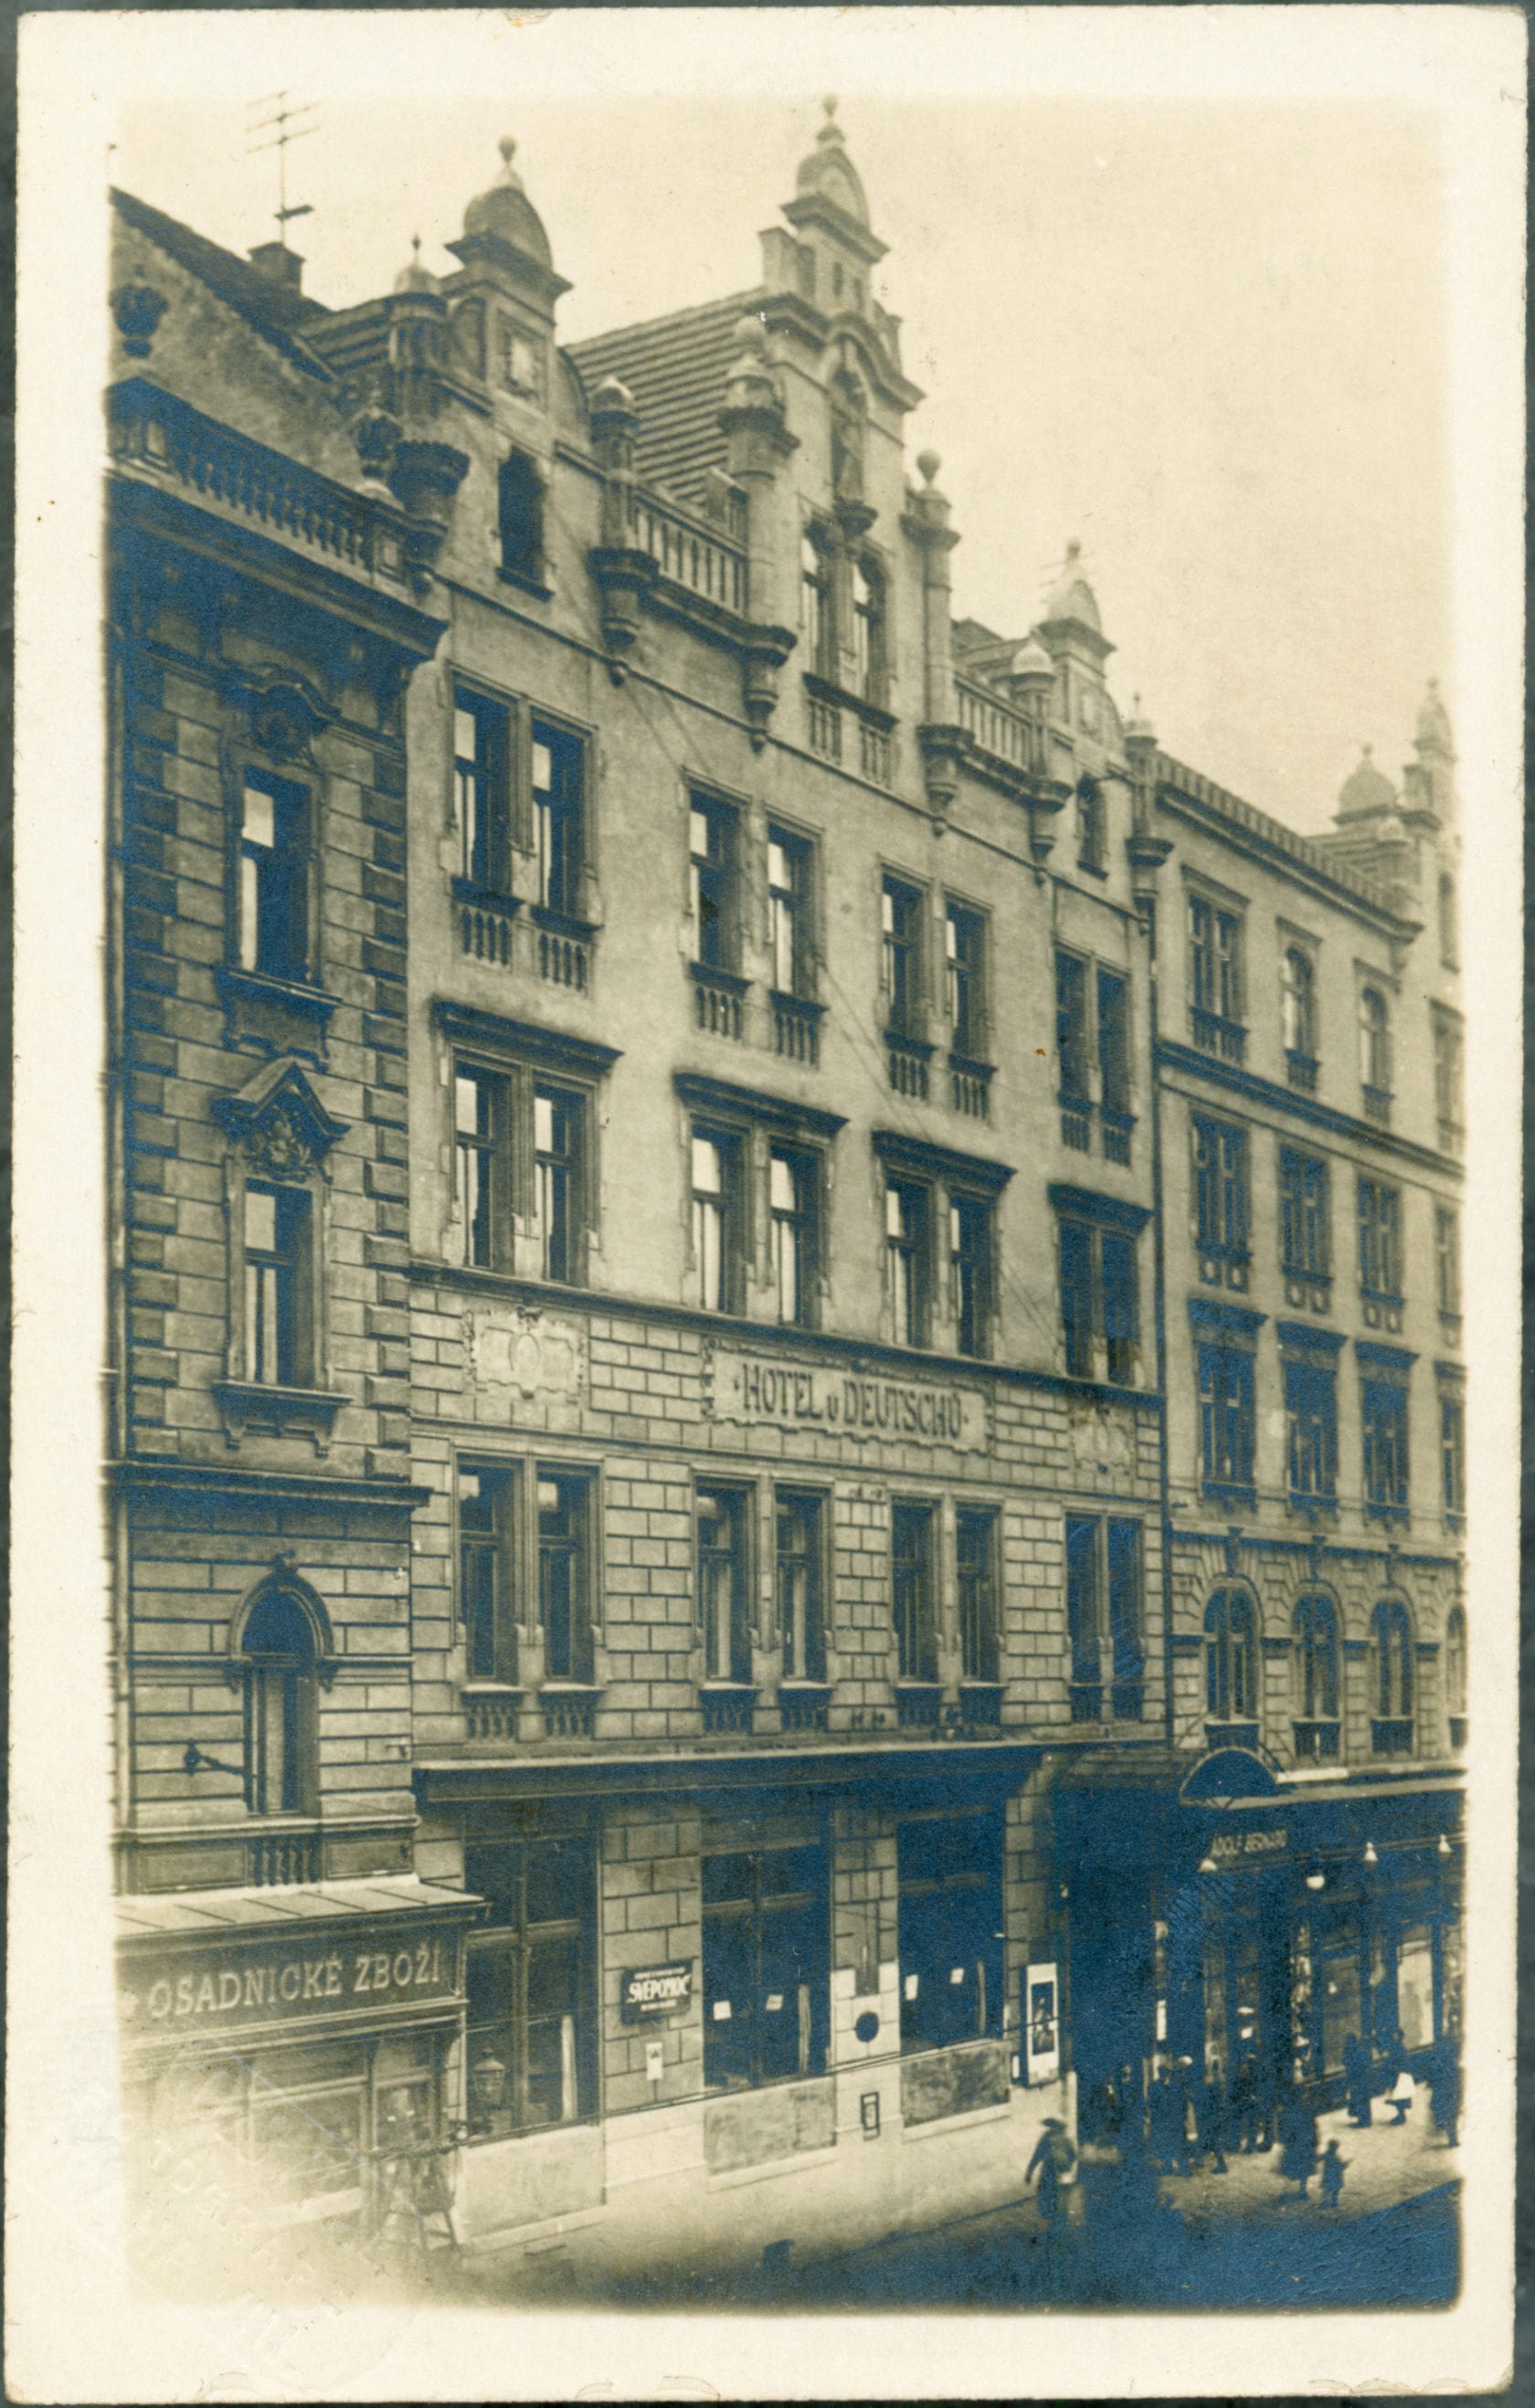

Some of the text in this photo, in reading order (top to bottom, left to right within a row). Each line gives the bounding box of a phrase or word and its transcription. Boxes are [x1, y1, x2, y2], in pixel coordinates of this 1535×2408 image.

[744, 1363, 822, 1420] HOTEL
[148, 1939, 442, 2019] OSADNICKÉ ZBOŽÍ
